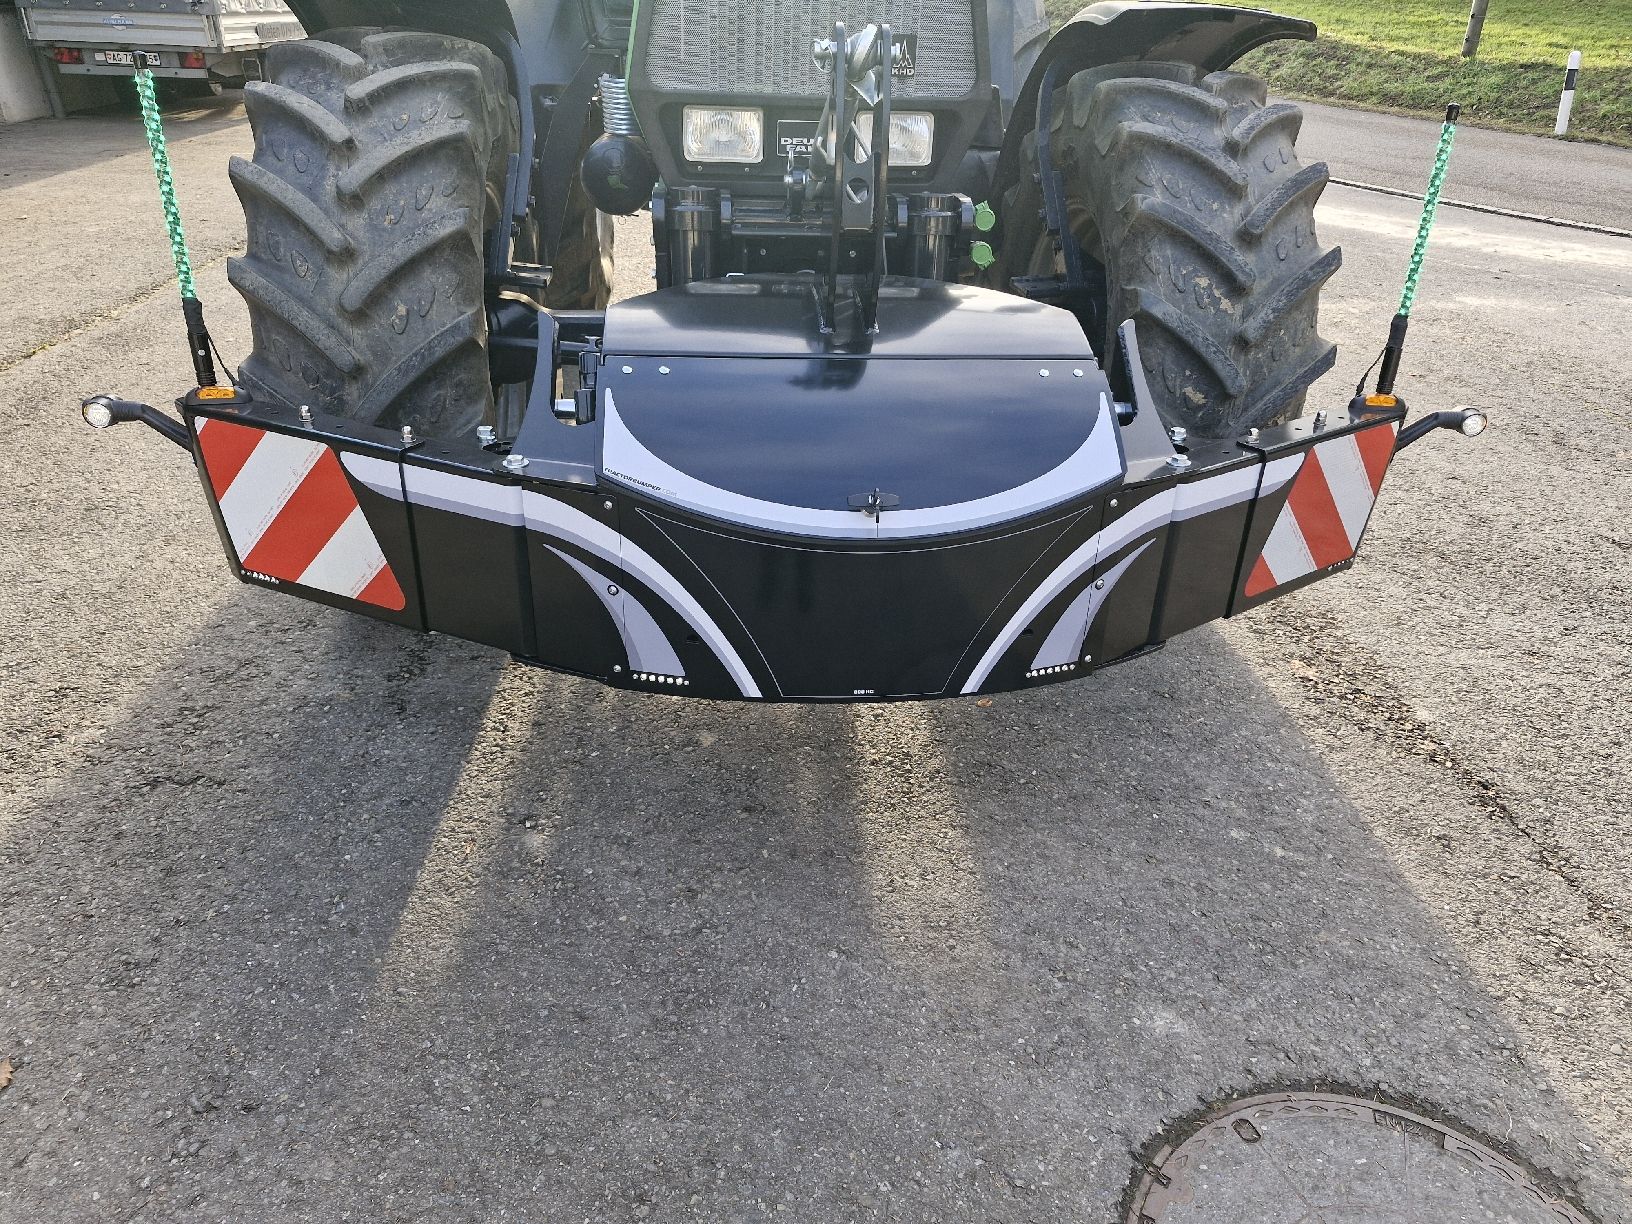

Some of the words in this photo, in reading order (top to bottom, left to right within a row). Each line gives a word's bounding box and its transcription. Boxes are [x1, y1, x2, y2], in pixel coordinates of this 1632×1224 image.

[112, 53, 122, 62] AG
[124, 53, 154, 64] 725
[780, 137, 815, 145] DEU
